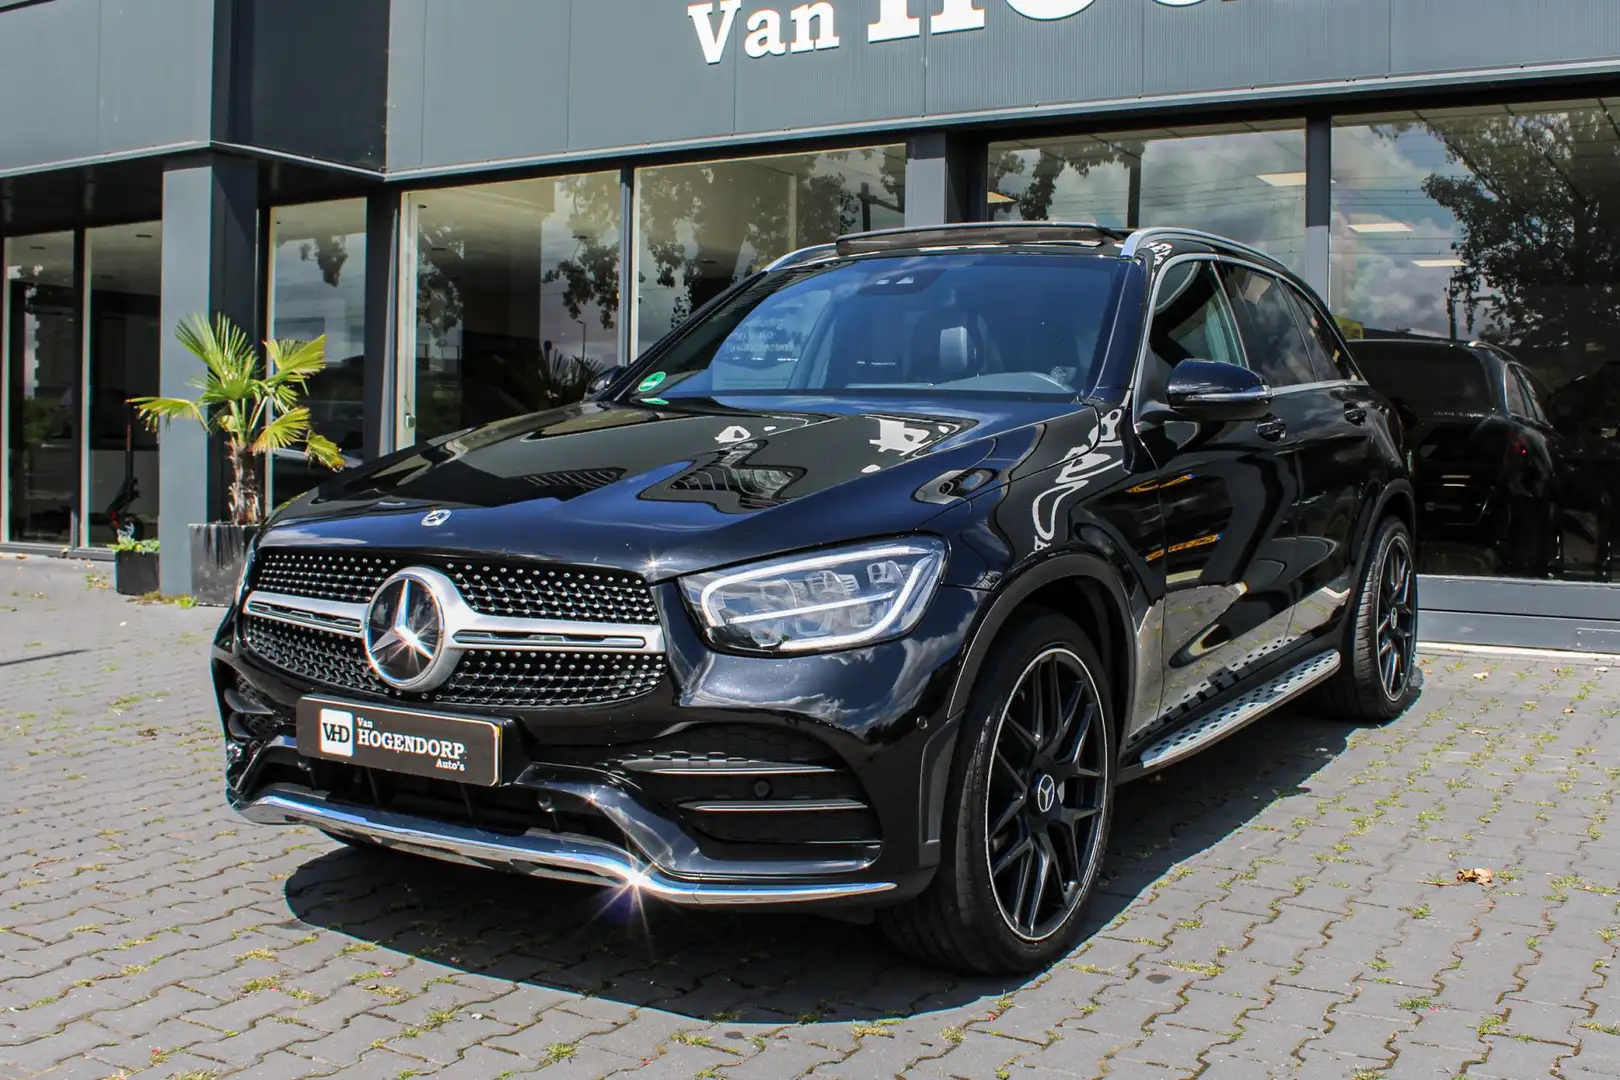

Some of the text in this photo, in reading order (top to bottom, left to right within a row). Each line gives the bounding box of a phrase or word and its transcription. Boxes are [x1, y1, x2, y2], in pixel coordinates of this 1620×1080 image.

[688, 0, 839, 64] Van
[357, 717, 373, 728] Van
[357, 728, 465, 759] HOGENDORP
[436, 759, 465, 771] Auto's
